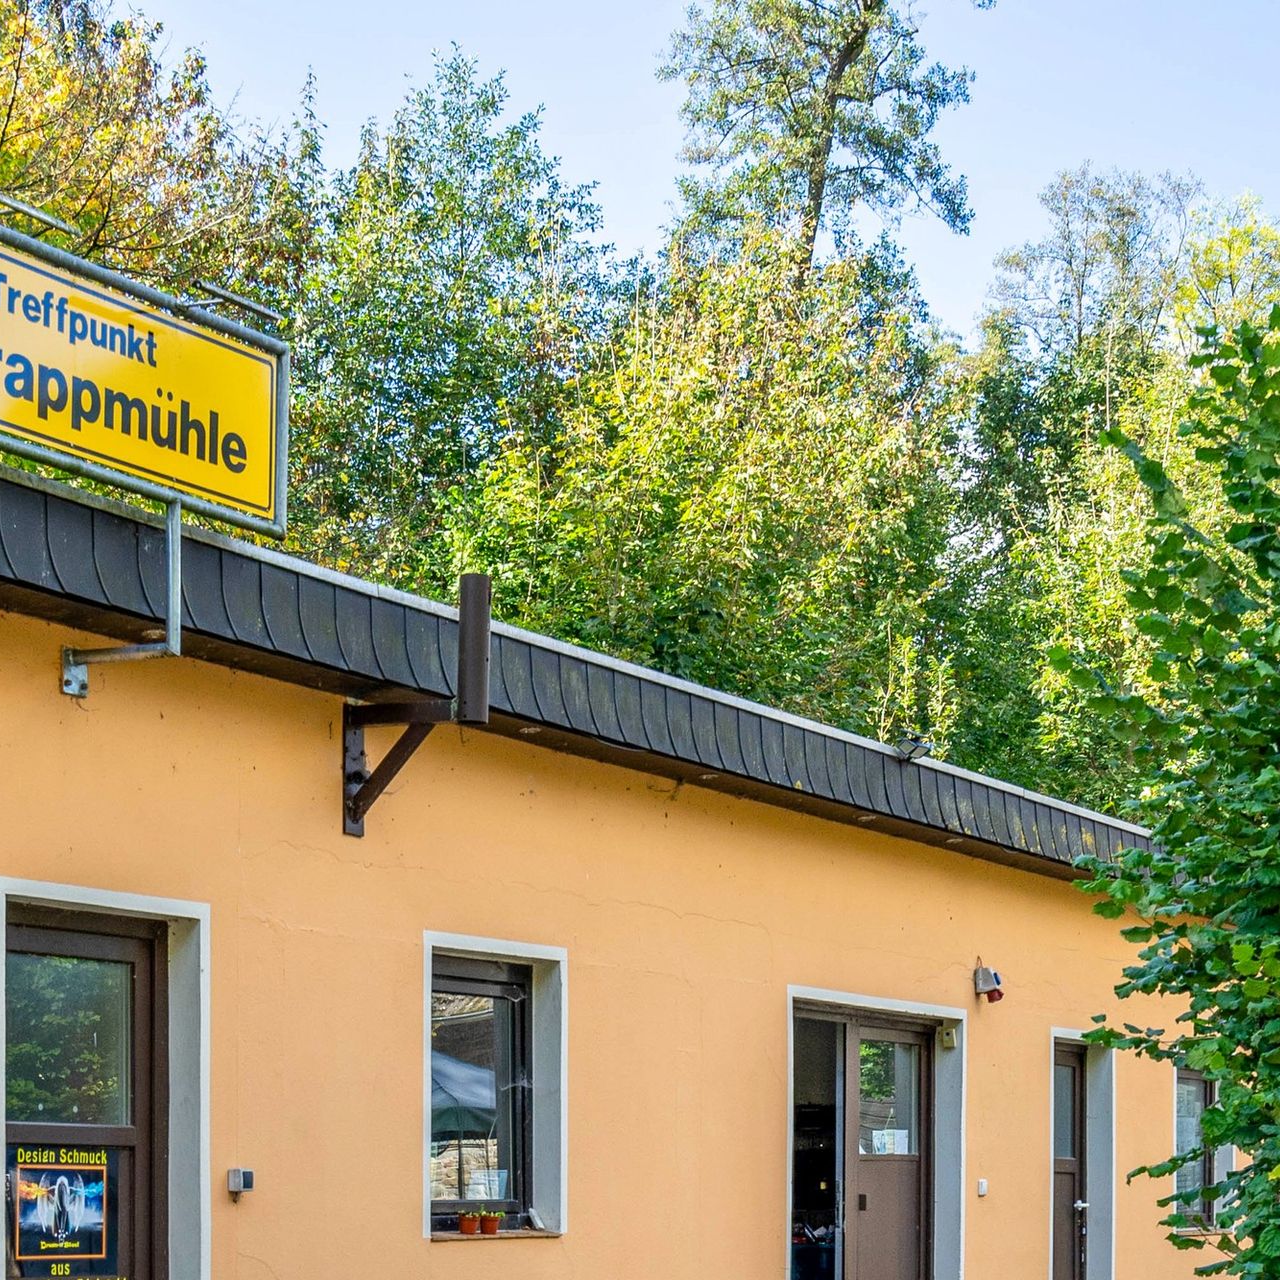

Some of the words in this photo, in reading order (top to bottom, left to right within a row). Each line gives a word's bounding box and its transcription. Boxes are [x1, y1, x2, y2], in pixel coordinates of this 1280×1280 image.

[17, 1148, 56, 1164] Design
[59, 1148, 108, 1165] Schmuck
[50, 1263, 70, 1276] aus
